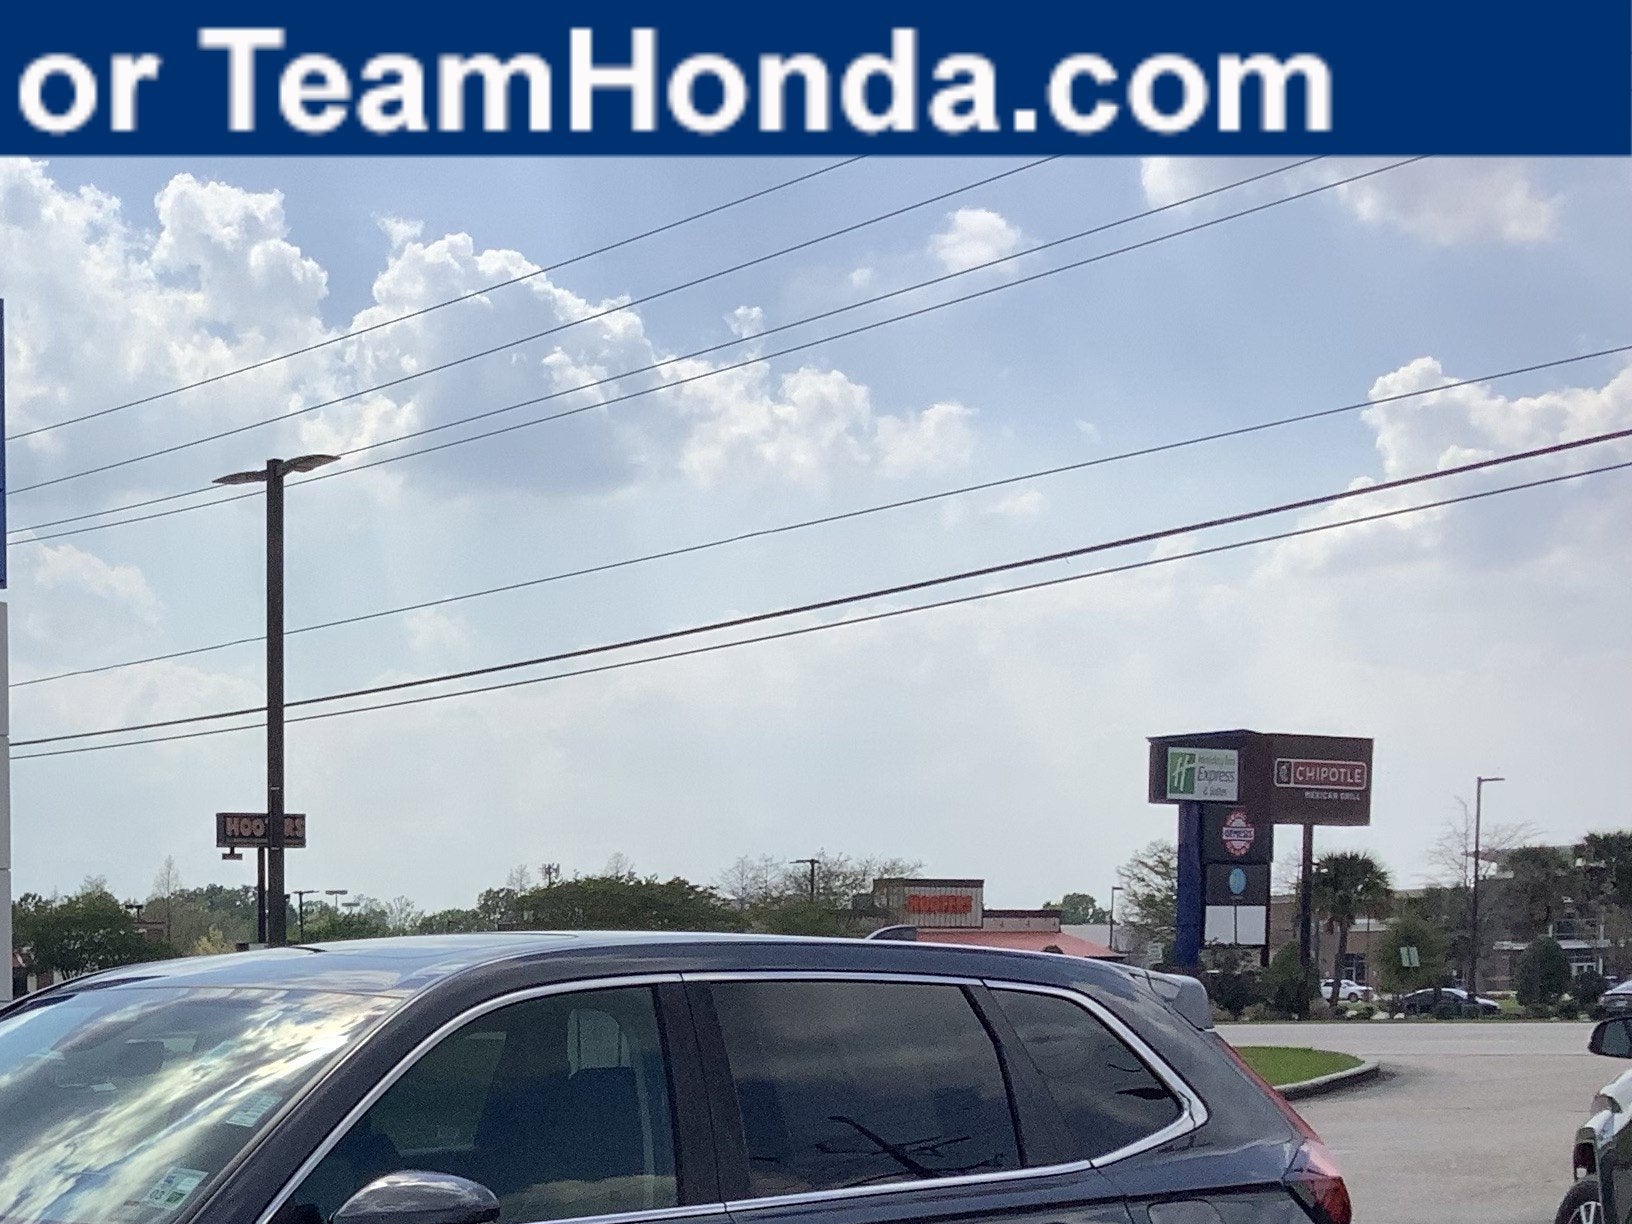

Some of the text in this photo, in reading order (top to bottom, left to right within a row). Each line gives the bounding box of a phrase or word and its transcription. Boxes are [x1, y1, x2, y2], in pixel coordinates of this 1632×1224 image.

[1197, 766, 1235, 783] Express
[1296, 766, 1362, 783] CHIPOTLE
[224, 817, 305, 838] HOORS
